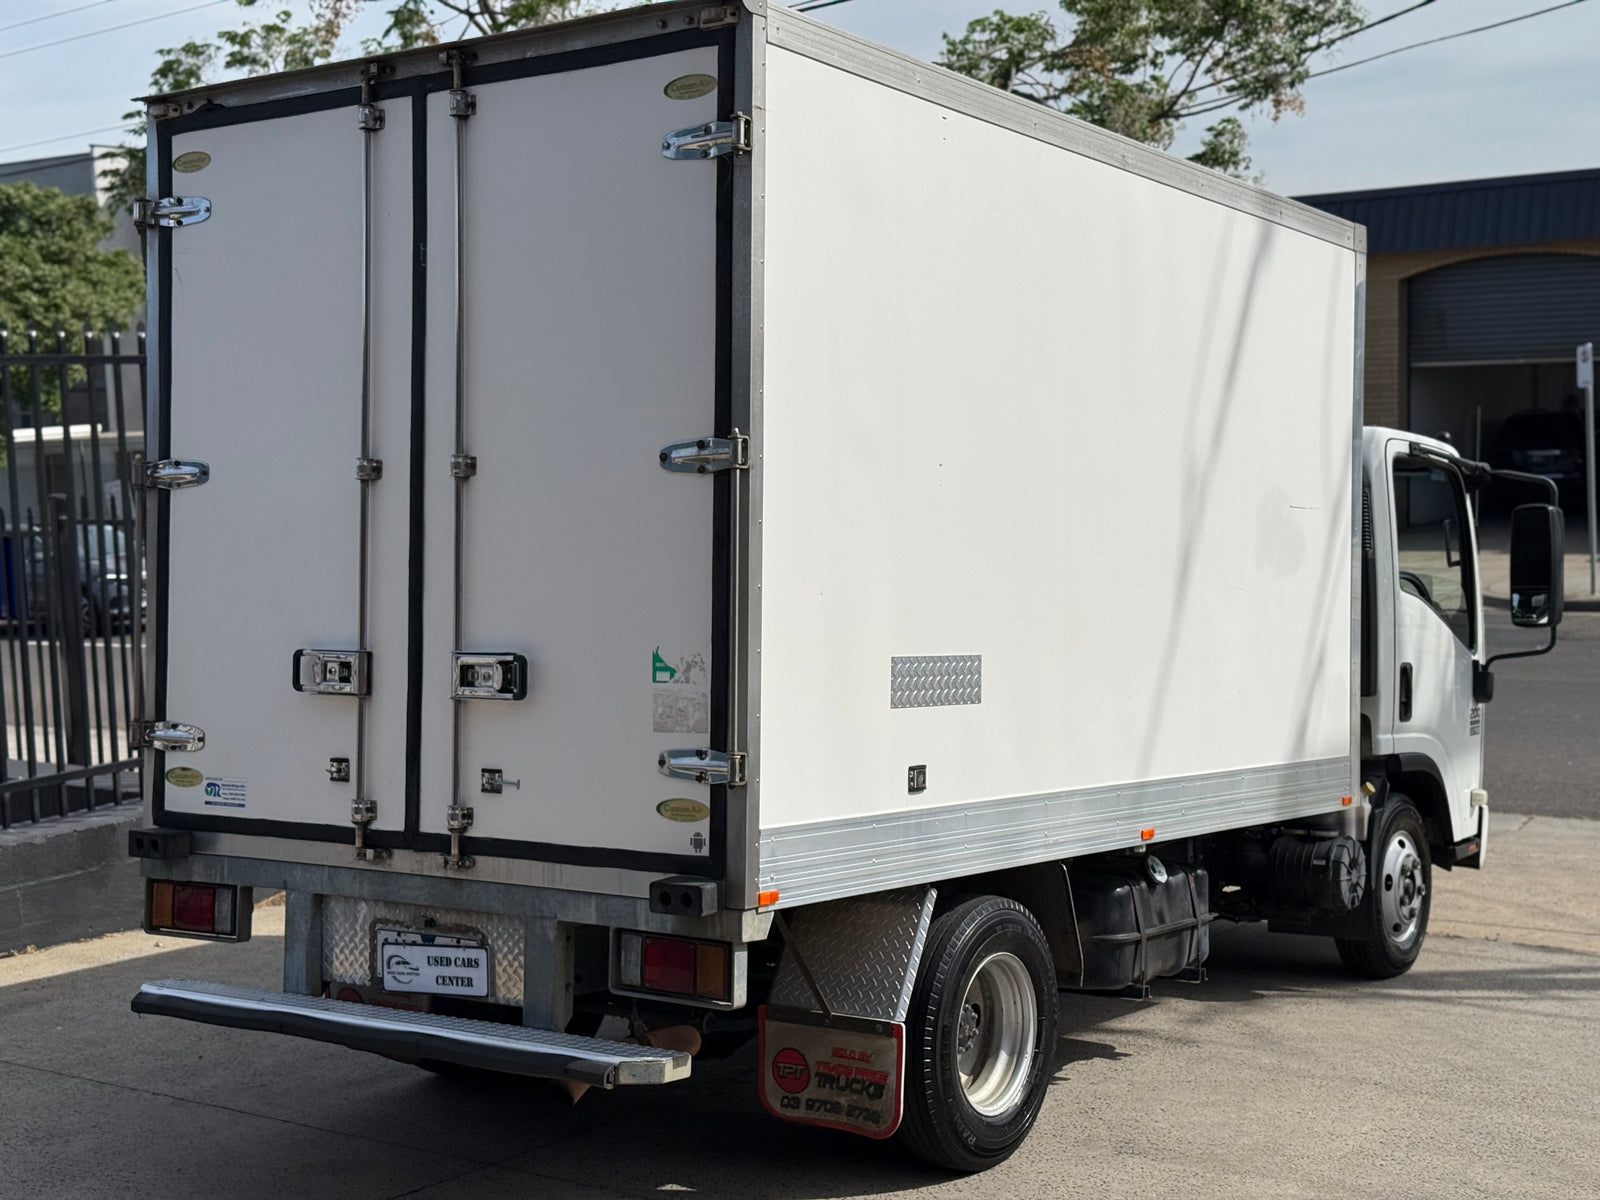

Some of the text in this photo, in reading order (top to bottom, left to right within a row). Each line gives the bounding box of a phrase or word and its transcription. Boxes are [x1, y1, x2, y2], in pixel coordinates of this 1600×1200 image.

[427, 955, 480, 969] USED CARS
[435, 975, 474, 988] CENTER
[775, 1062, 809, 1080] TPT
[814, 1072, 887, 1101] TRUCKS
[780, 1095, 801, 1110] 03
